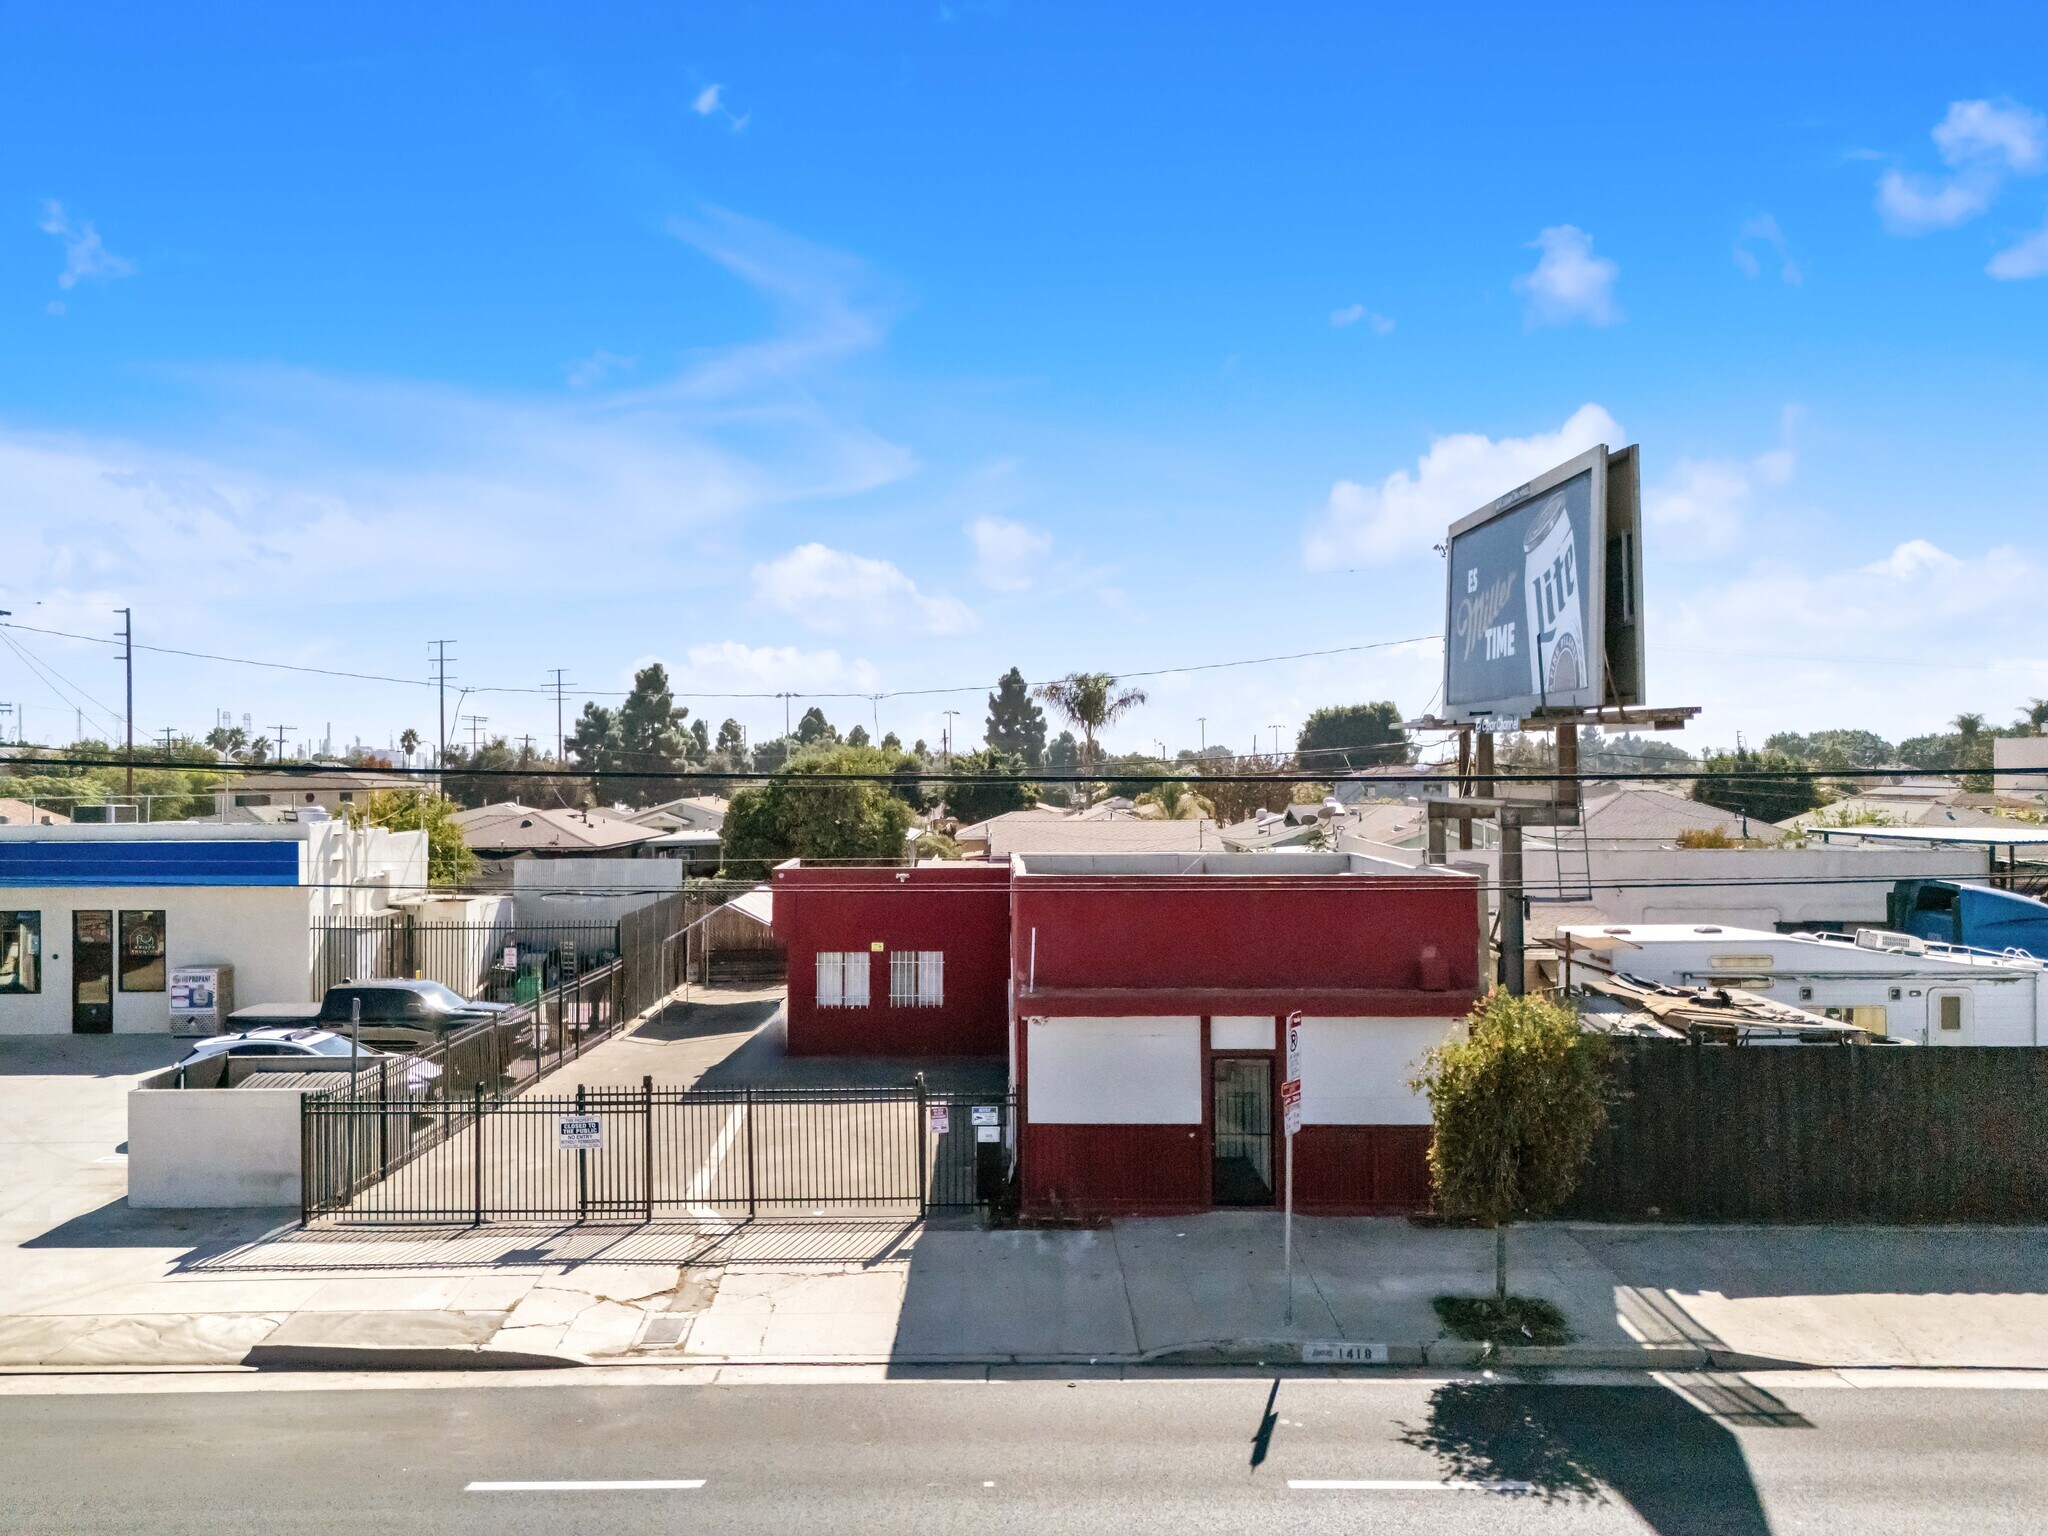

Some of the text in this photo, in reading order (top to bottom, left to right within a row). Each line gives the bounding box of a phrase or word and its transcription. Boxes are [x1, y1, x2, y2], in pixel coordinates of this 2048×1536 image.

[1468, 568, 1478, 593] ES
[1457, 570, 1516, 661] Miller
[1484, 622, 1516, 661] TIME
